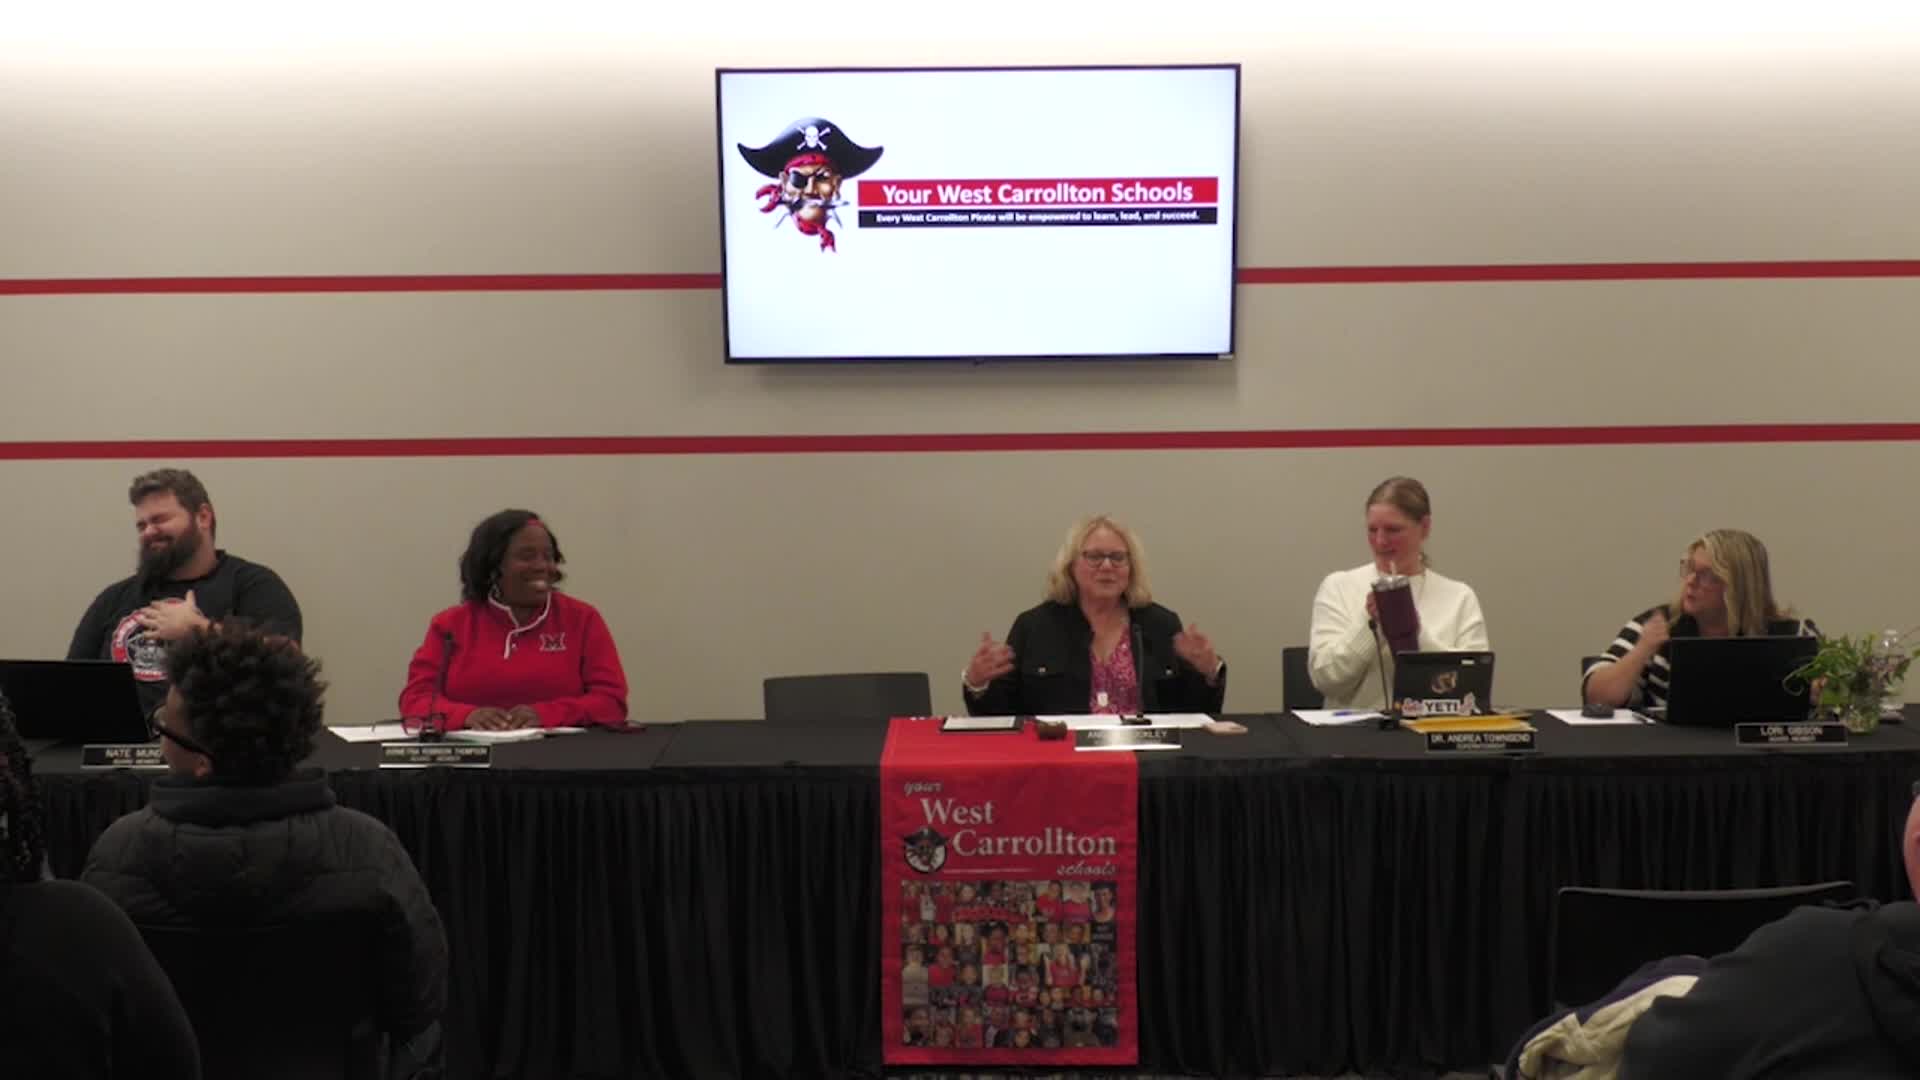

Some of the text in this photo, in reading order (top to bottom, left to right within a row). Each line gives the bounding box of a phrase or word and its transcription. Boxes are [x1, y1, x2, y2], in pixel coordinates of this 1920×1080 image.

[882, 181, 1194, 204] Your West Carrollton Schools
[876, 210, 1200, 225] Every West Carrollton Pirate will be empowered to learn, lead, and succeed.
[1424, 702, 1458, 713] YETI
[1447, 733, 1482, 743] ANDREA
[1484, 733, 1530, 743] TOWNSEND
[1760, 727, 1784, 737] LORI
[105, 748, 130, 758] NATE
[904, 782, 942, 796] your
[920, 798, 994, 825] West
[951, 827, 1118, 857] Carrollton
[1056, 860, 1117, 876] schools
